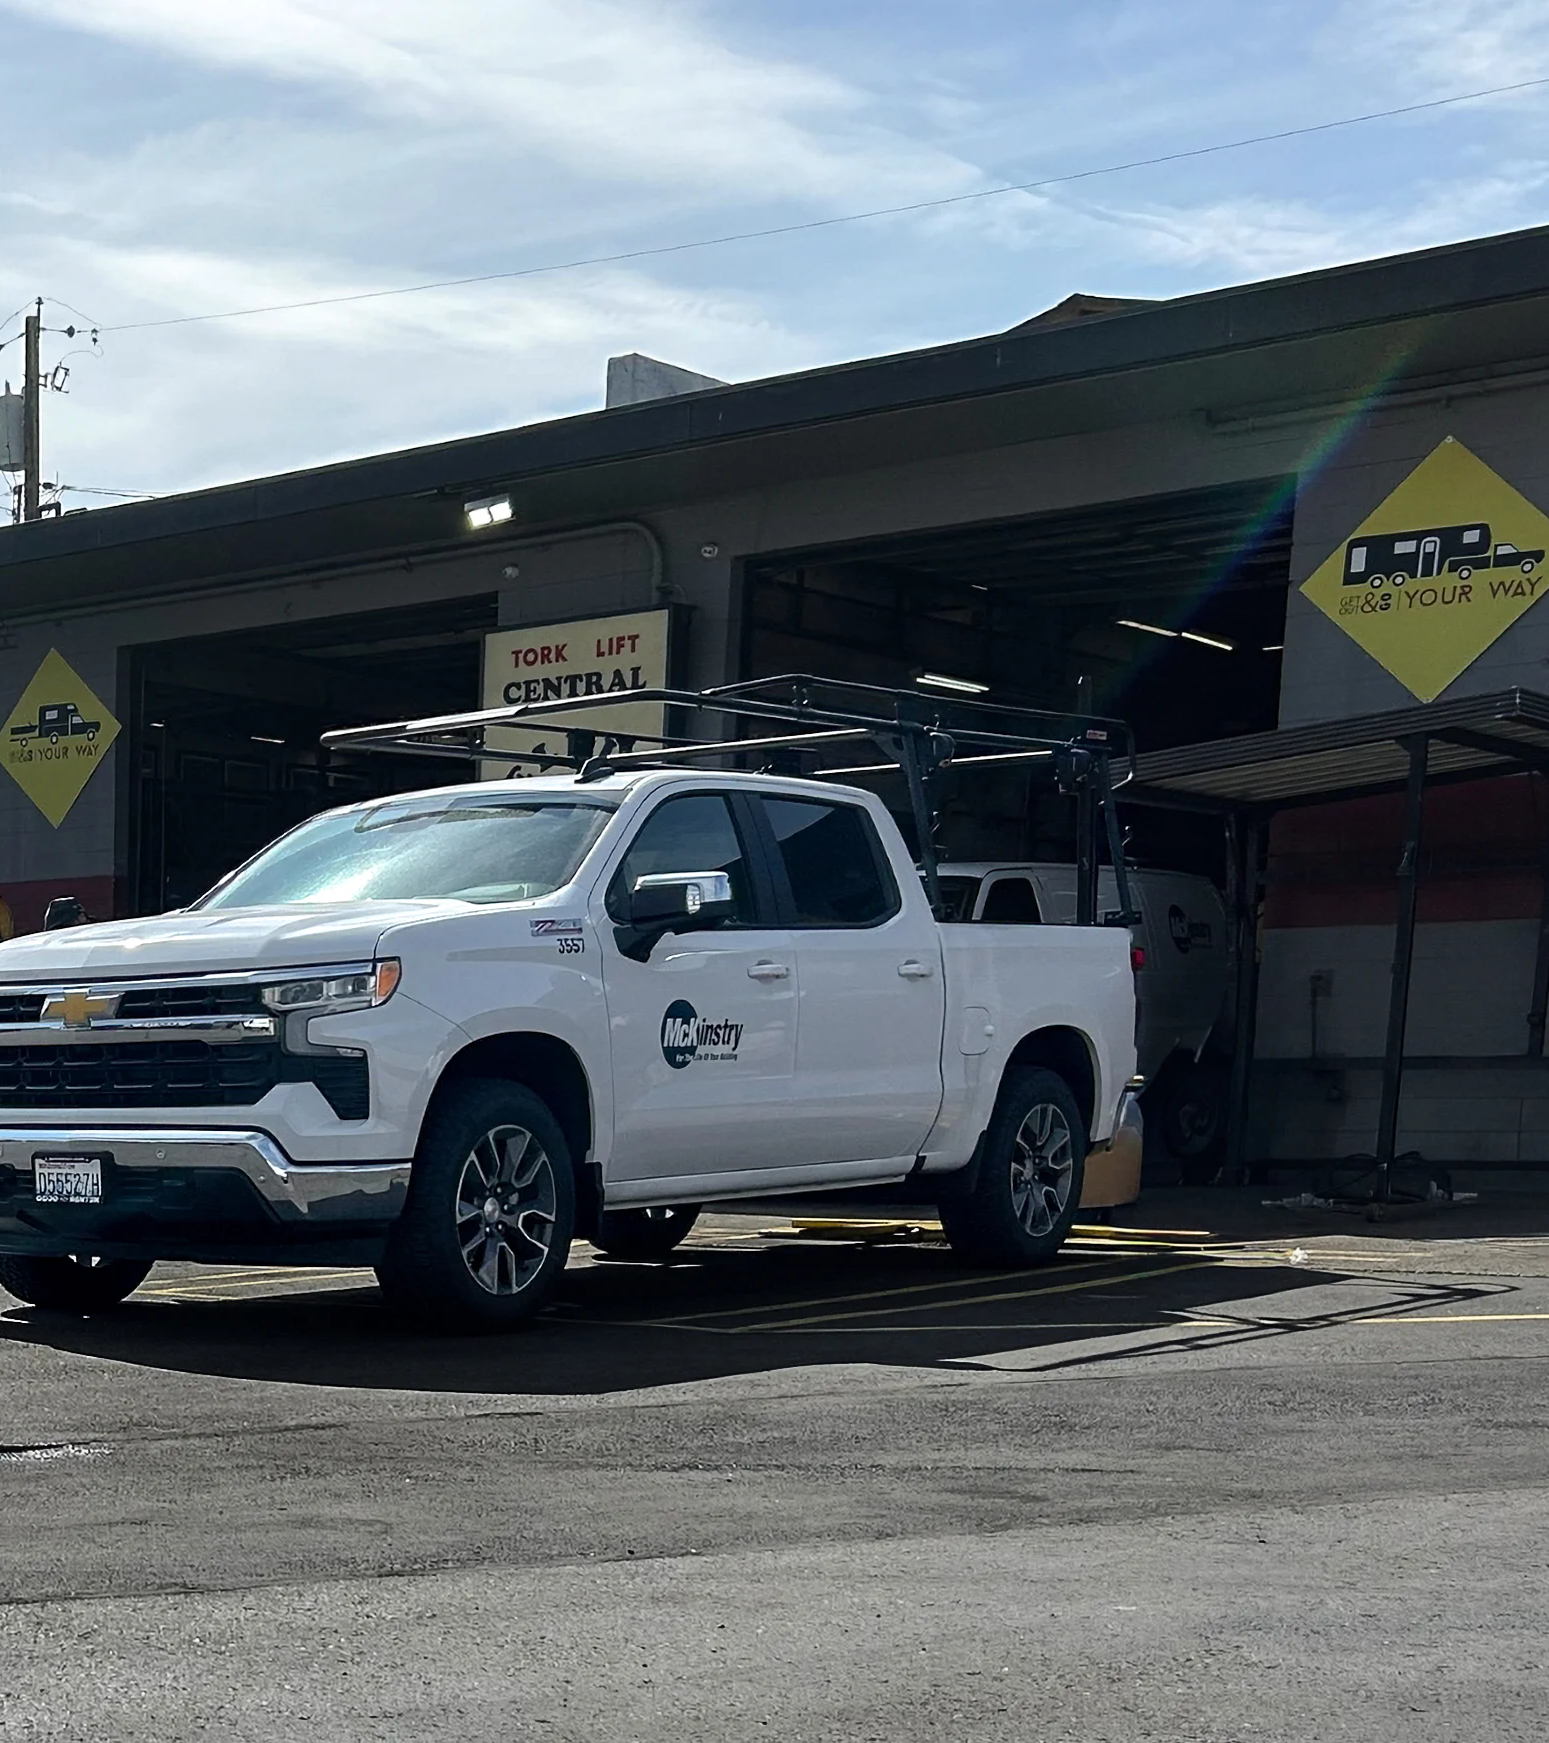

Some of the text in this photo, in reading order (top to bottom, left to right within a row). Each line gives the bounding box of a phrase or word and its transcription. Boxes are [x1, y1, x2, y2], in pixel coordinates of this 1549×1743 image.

[1404, 584, 1473, 609] YOUR
[1489, 576, 1543, 600] WAY
[511, 634, 640, 668] TORK LIFT
[503, 666, 647, 705] CENTRAL
[37, 746, 69, 761] YOUR
[75, 744, 99, 757] WAY
[556, 937, 585, 954] 3557
[662, 1017, 744, 1051] McKinstry
